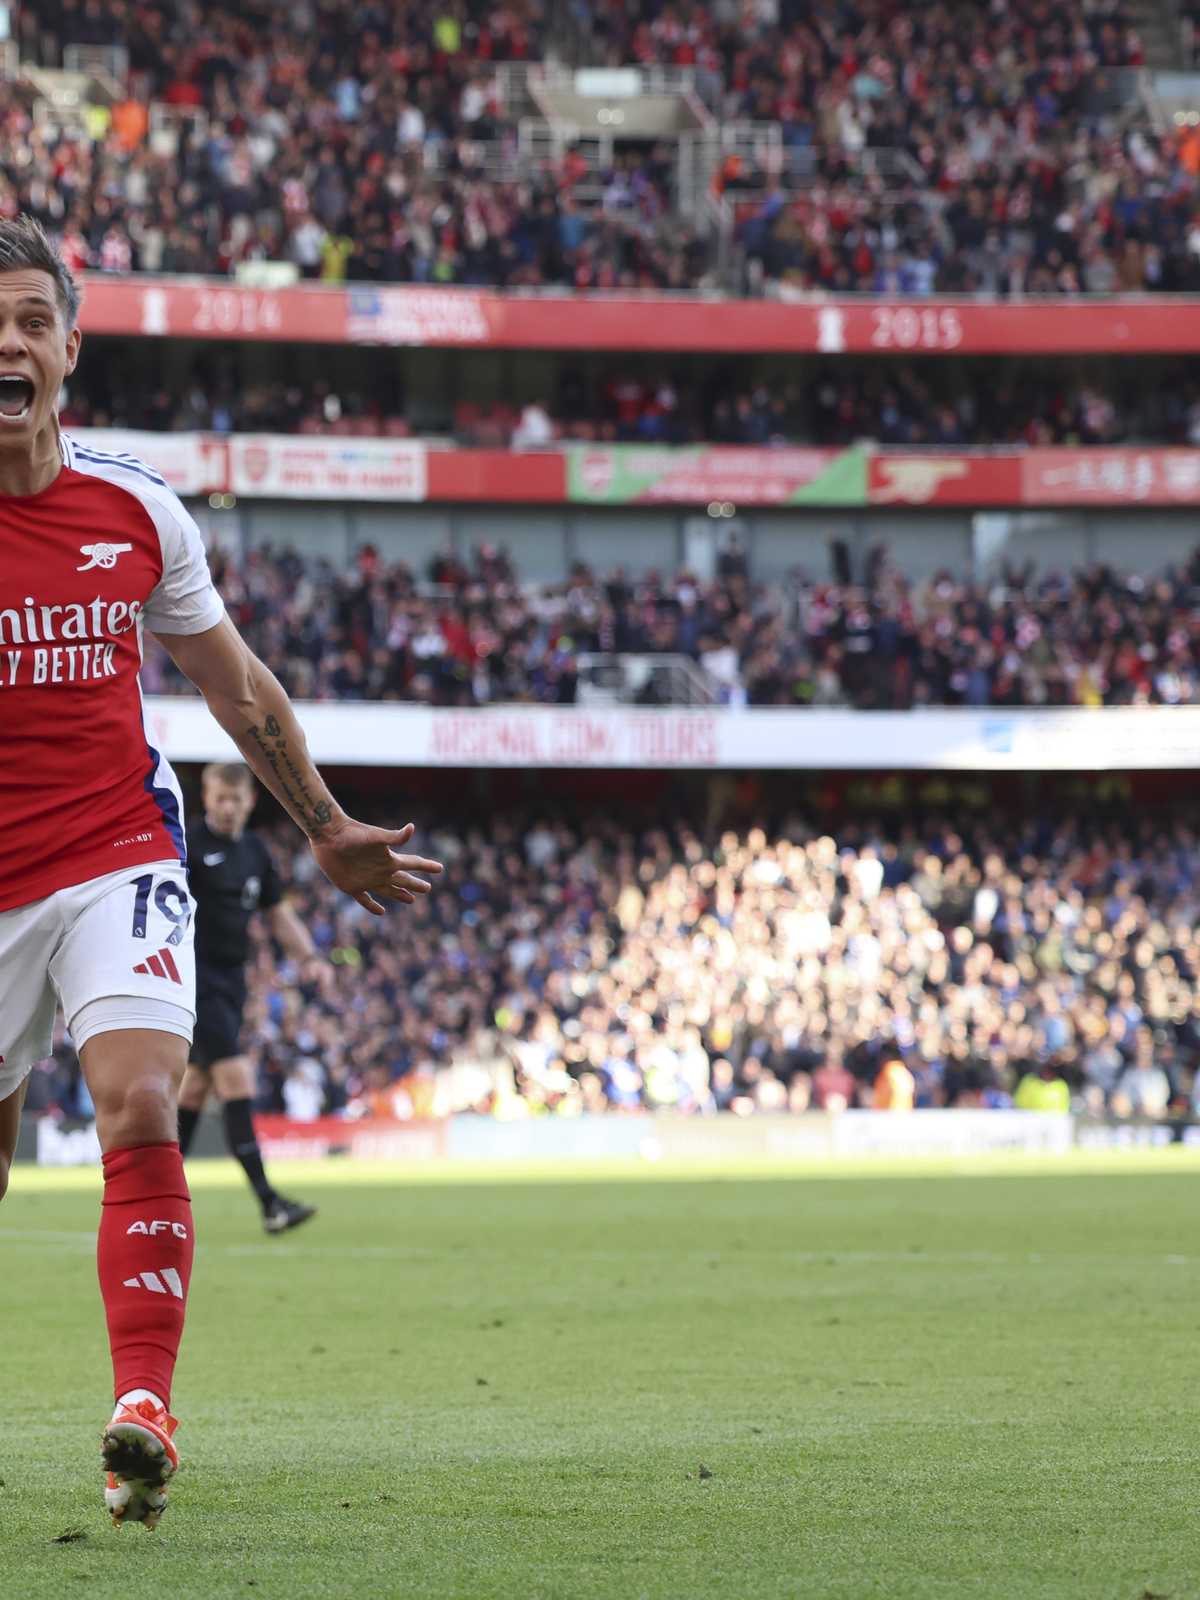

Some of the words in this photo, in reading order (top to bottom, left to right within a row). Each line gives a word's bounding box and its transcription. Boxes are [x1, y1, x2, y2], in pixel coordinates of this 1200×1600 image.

[193, 289, 282, 332] 2014
[871, 306, 964, 350] 2015
[33, 643, 117, 684] BETTER
[129, 873, 192, 948] 19
[125, 1219, 188, 1240] AFC
